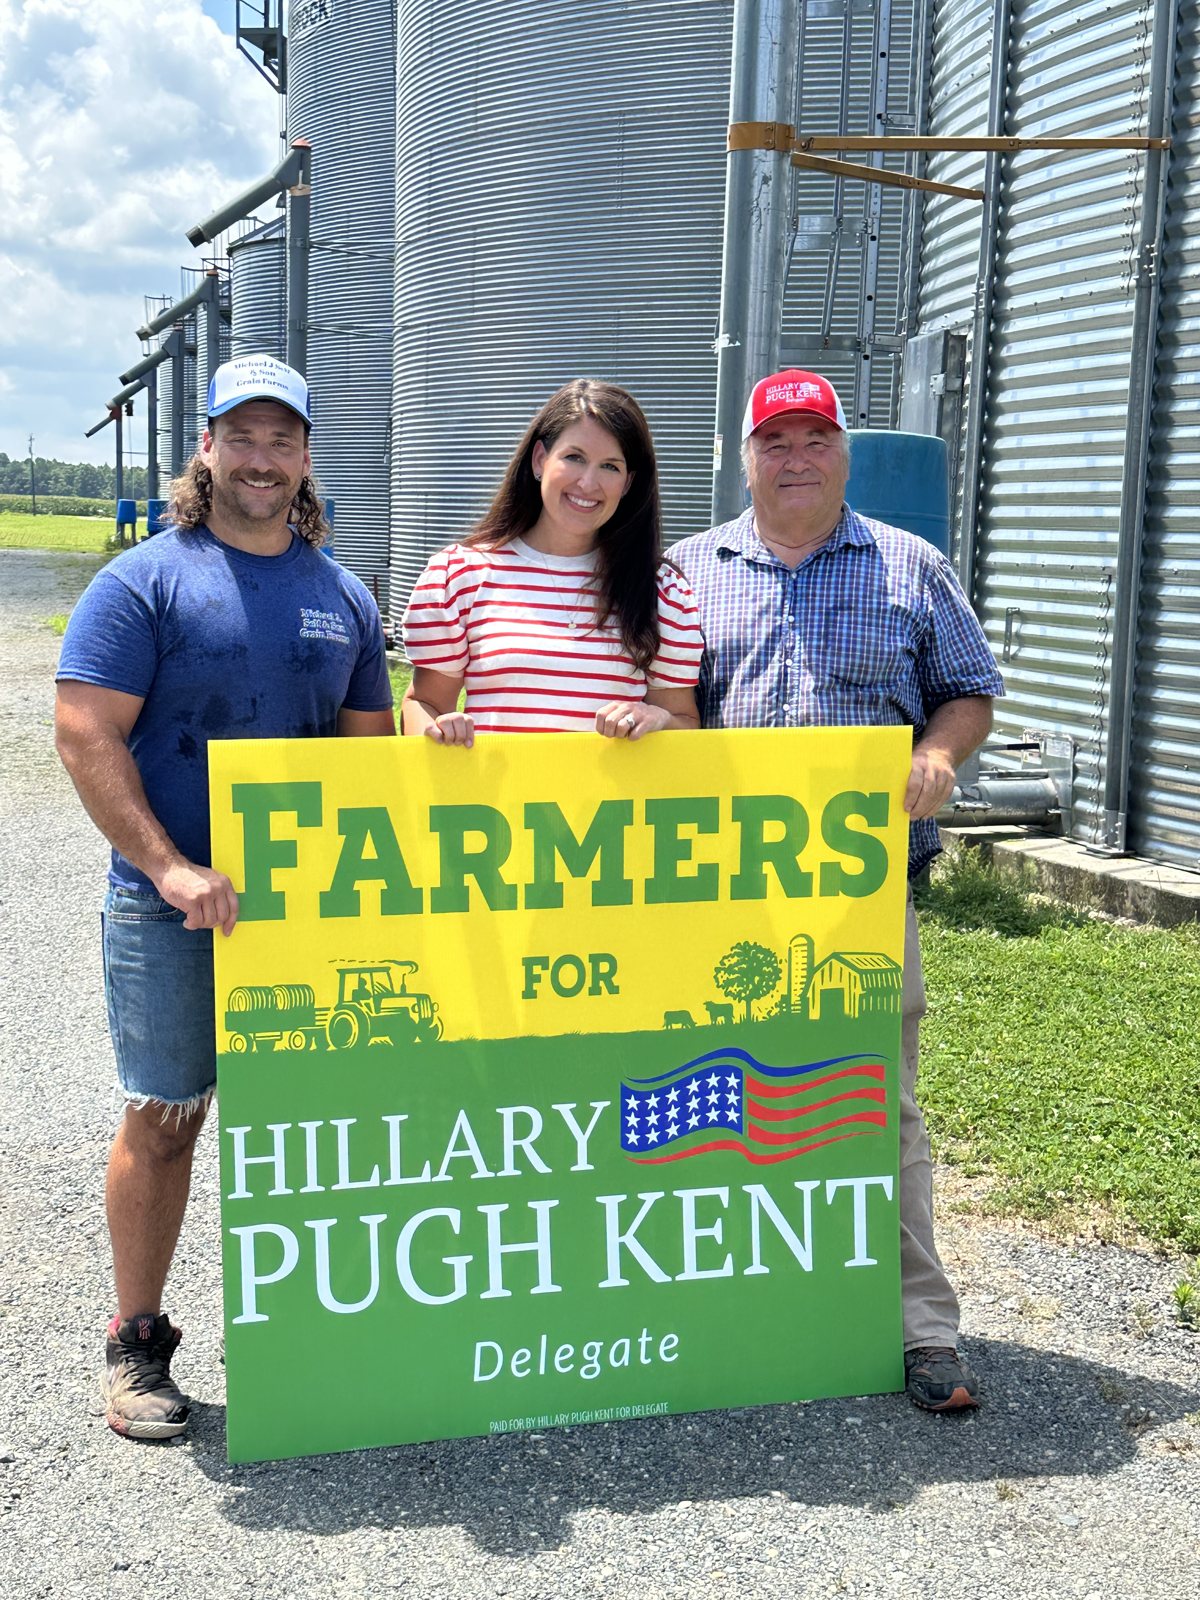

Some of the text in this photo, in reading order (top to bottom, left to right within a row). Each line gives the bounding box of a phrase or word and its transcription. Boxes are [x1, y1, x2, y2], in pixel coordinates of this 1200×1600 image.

[234, 361, 267, 369] Michael
[236, 378, 289, 390] Grain Farms
[766, 382, 799, 395] HILLARY
[766, 391, 793, 404] PUGH
[796, 390, 822, 400] KENT
[300, 608, 334, 620] Michael
[330, 621, 346, 634] Son
[300, 628, 350, 644] Grain Farms
[231, 781, 890, 922] FARMERS
[521, 952, 619, 999] FOR
[226, 1101, 611, 1199] HILLARY
[229, 1175, 894, 1325] PUGH KENT
[473, 1327, 680, 1382] Delegate
[490, 1402, 669, 1433] PAID FOR BY HILLARY PUGH KENT FOR DELEGATE
